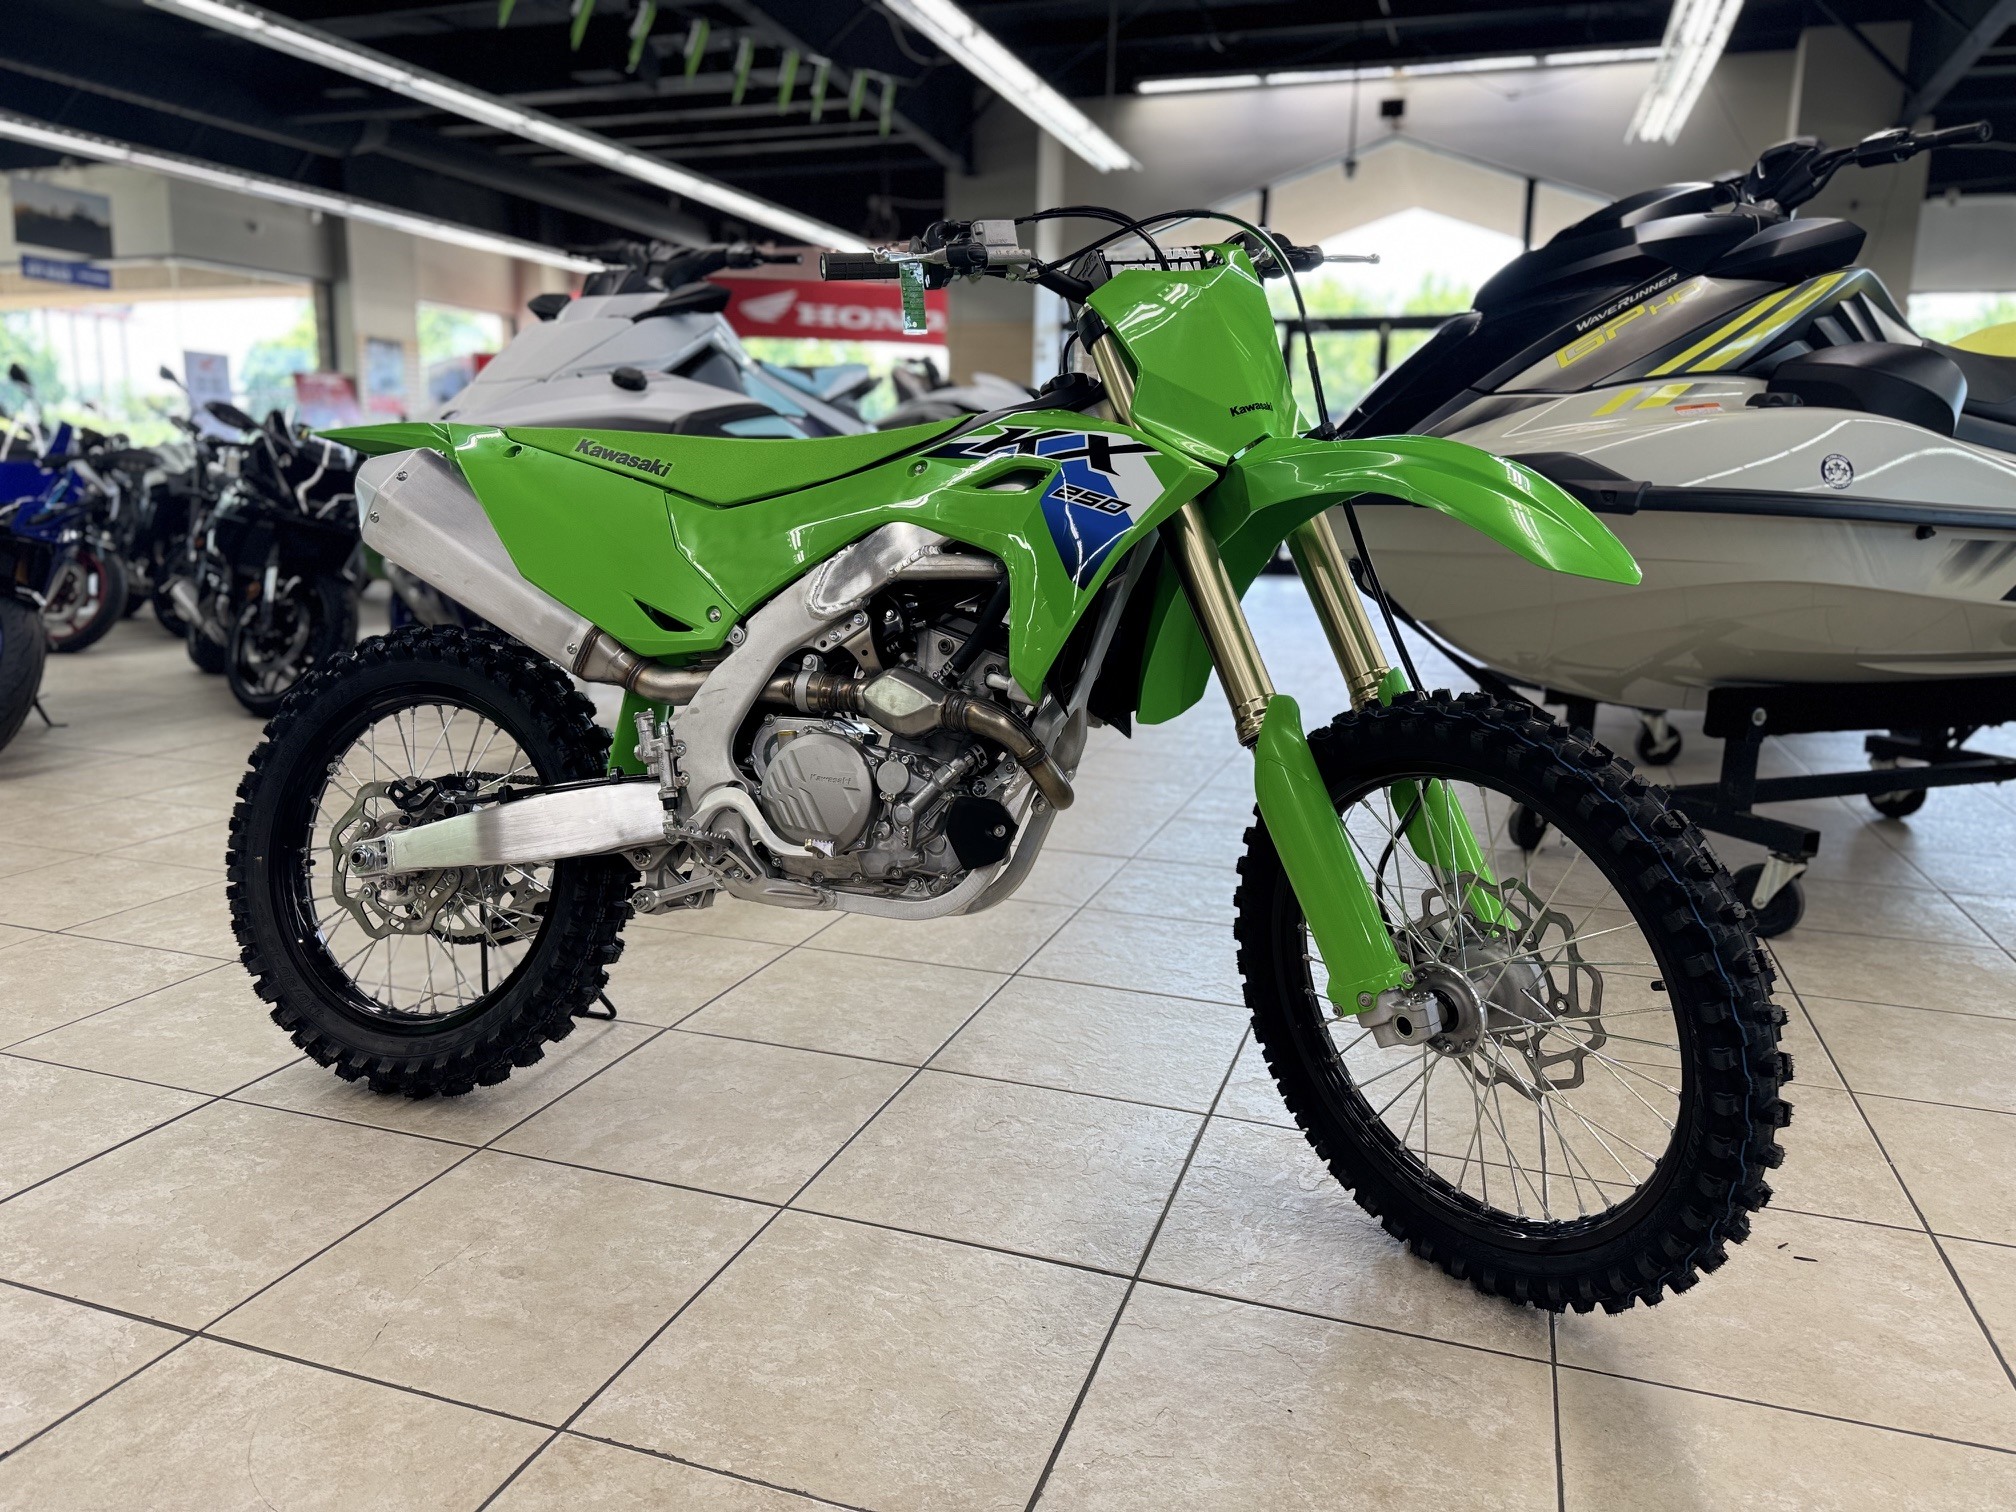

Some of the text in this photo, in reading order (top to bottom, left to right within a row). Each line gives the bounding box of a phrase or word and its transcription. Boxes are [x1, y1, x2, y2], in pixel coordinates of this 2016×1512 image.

[1229, 401, 1274, 418] Kawasaki
[574, 438, 674, 478] Kawasaki
[958, 424, 1165, 478] KX
[1048, 483, 1132, 516] 250
